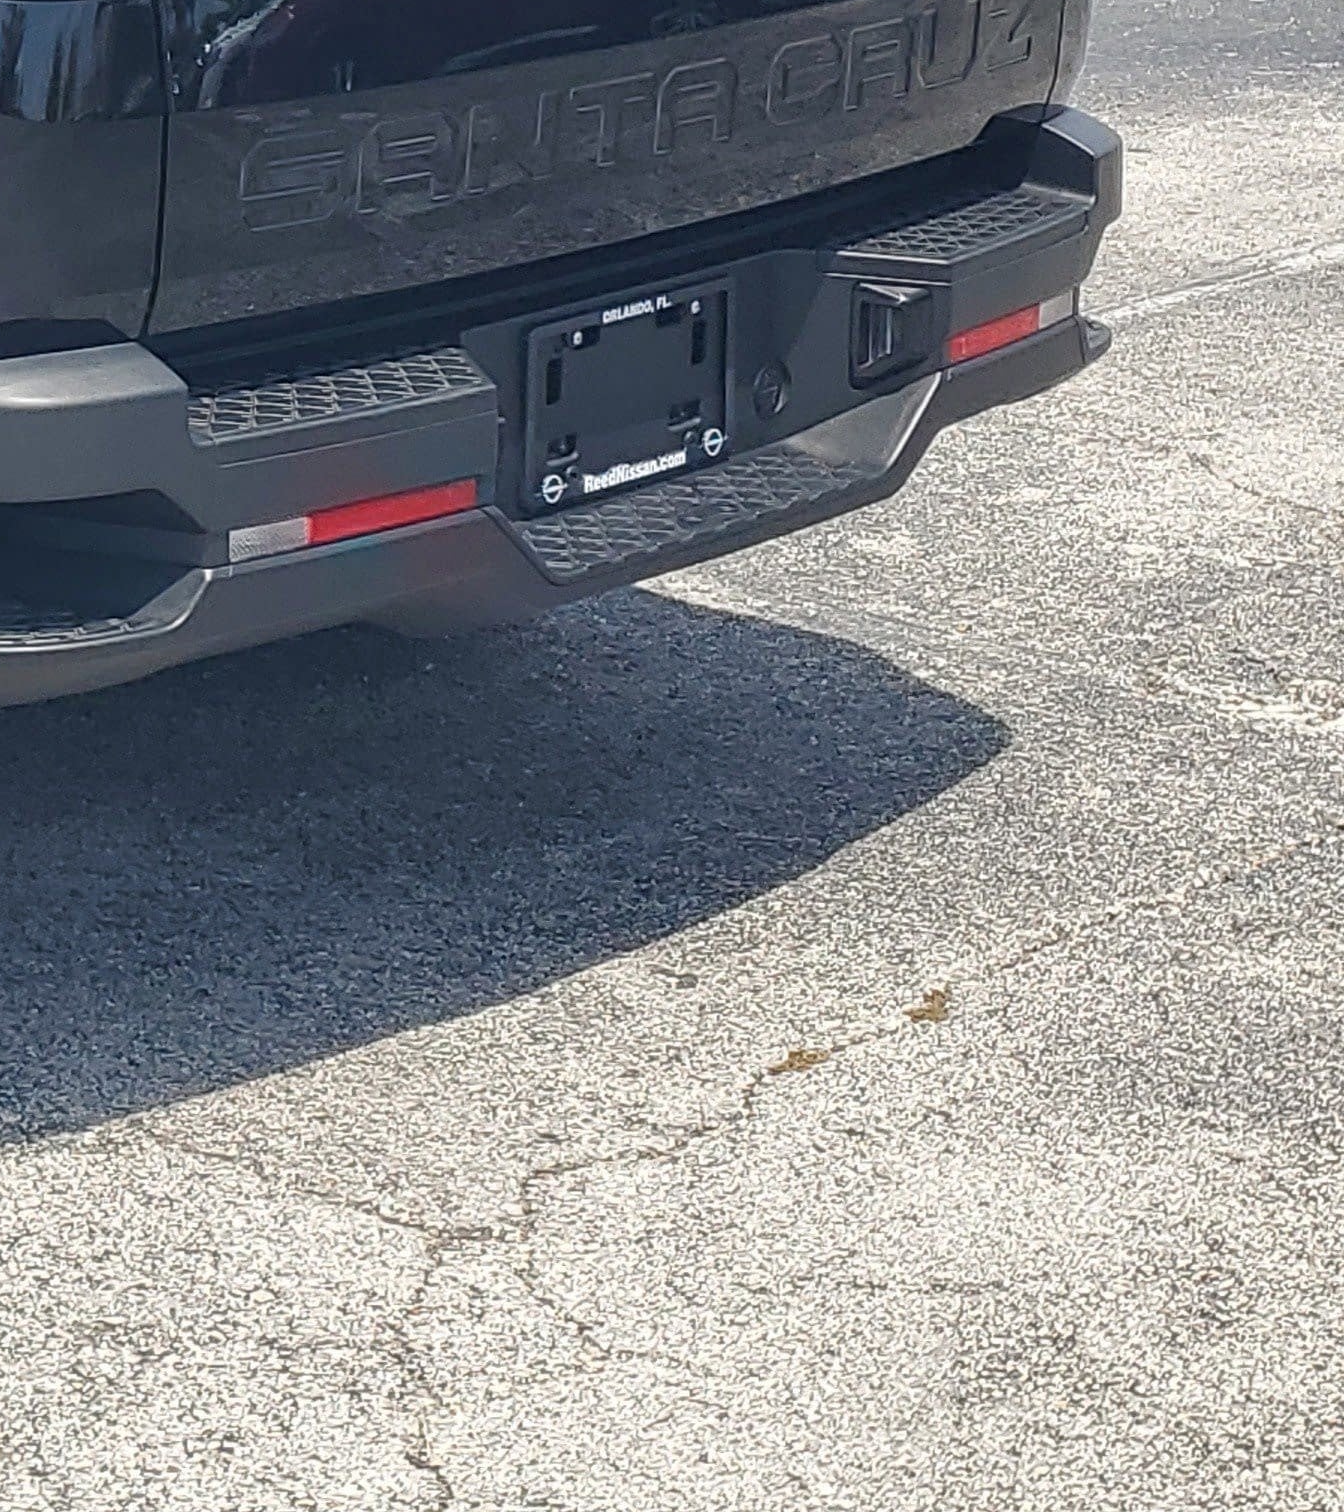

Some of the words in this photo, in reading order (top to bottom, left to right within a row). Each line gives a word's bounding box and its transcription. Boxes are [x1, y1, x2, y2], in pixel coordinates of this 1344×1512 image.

[238, 56, 739, 232] SANTA
[601, 299, 655, 324] ORLANDO,
[583, 448, 687, 494] ReedNissan.com
